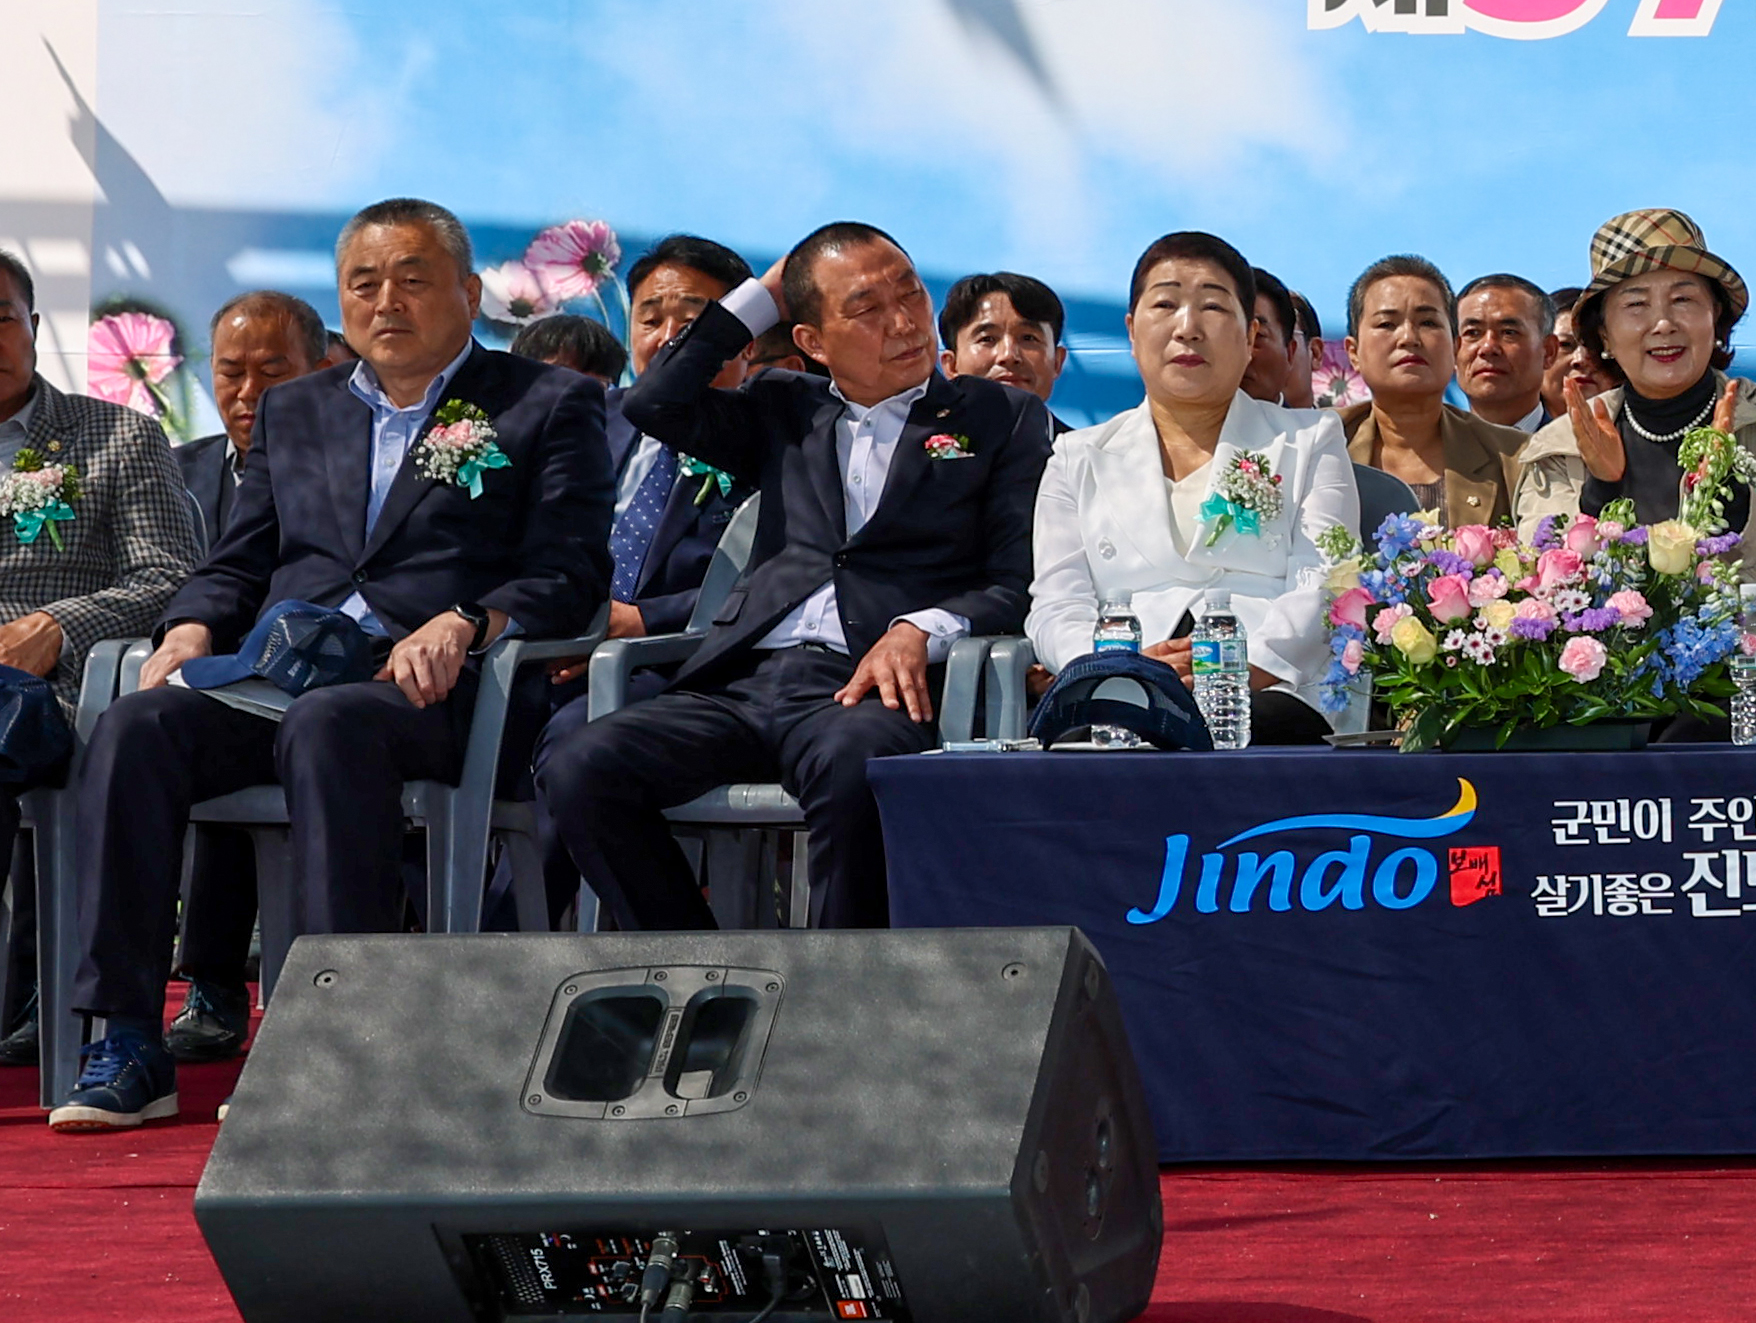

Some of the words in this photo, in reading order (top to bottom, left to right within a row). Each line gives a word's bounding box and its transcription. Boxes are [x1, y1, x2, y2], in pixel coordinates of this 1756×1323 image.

[1550, 797, 1673, 846] 군민이
[1126, 834, 1438, 925] Jindo
[1530, 872, 1675, 917] 살기좋은
[531, 1248, 558, 1290] PRX715
